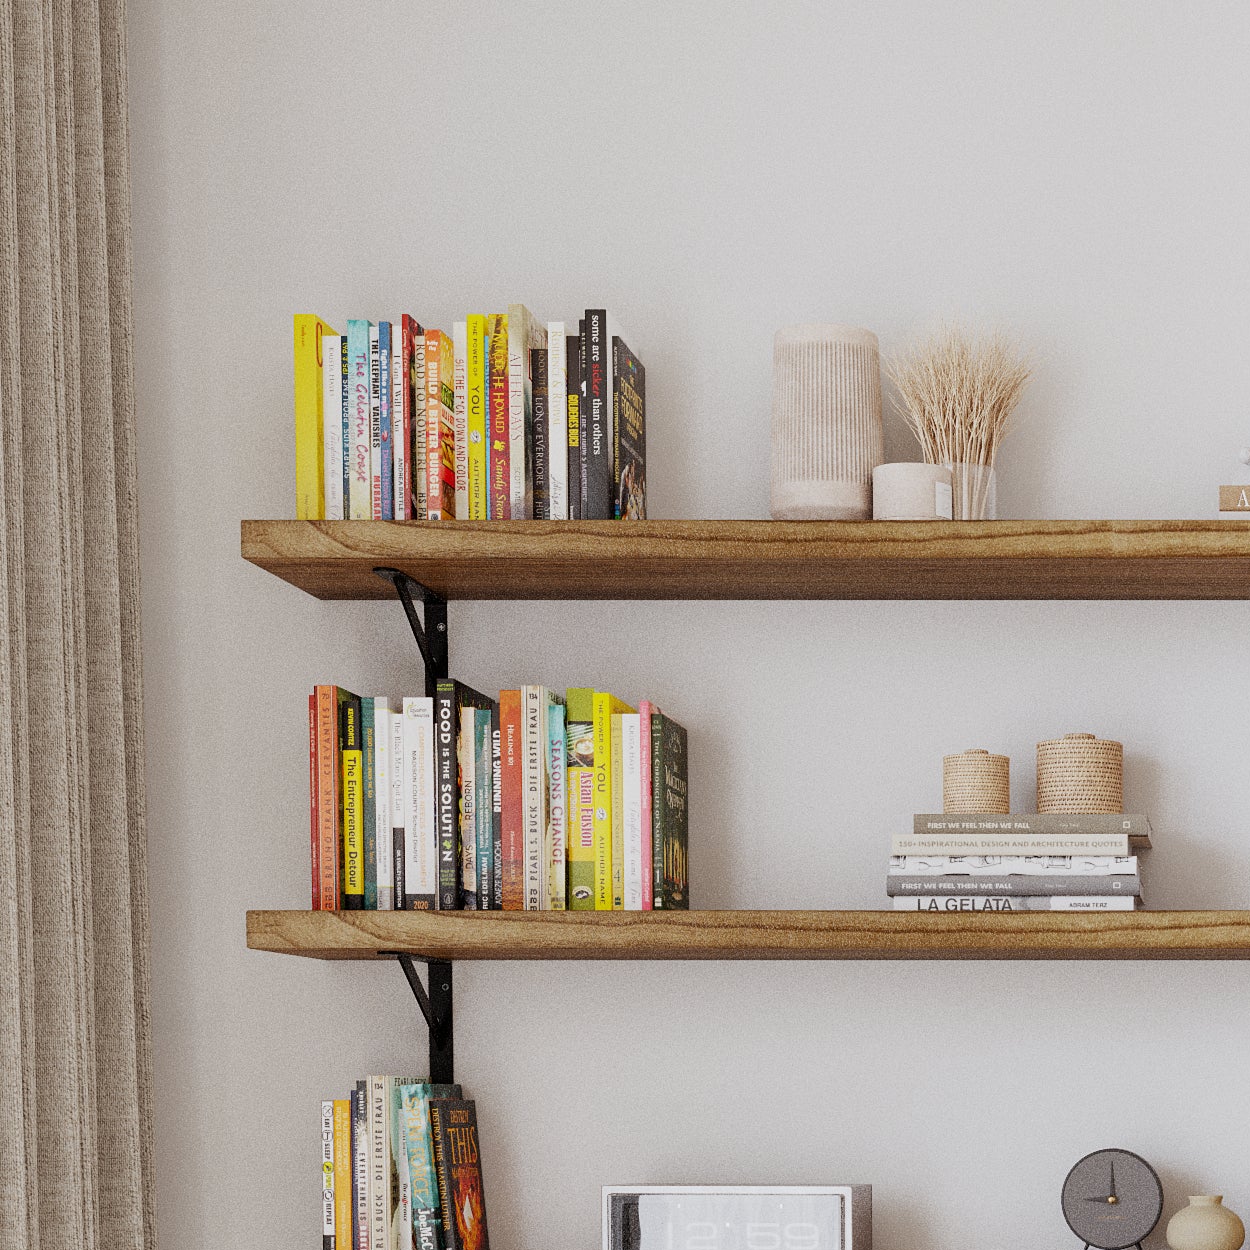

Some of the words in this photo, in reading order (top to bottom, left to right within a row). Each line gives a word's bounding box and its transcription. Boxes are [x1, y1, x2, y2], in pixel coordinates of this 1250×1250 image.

[592, 315, 600, 342] some
[372, 340, 380, 355] THE
[416, 344, 426, 380] ROAD
[592, 345, 600, 362] are
[357, 353, 368, 377] The
[372, 360, 380, 399] ELEPHANT
[428, 362, 439, 395] BUILD
[510, 353, 522, 399] AFTER
[592, 363, 602, 397] sicker
[416, 386, 426, 402] TO
[428, 398, 439, 406] A
[593, 398, 602, 421] than
[357, 383, 368, 438] Gelatin
[510, 405, 522, 442] DAYS
[568, 395, 579, 426] GOLDENES
[372, 406, 380, 448] VANISHES
[416, 409, 426, 473] NOWHERE
[428, 409, 439, 448] BETTER
[568, 429, 579, 447] BUCH
[593, 423, 602, 455] others
[357, 445, 368, 482] Coast
[428, 452, 439, 497] BURGER
[528, 707, 537, 735] FRAU
[348, 757, 357, 777] The
[528, 740, 537, 770] ERSTE
[551, 739, 561, 802] SEASONS
[528, 776, 537, 792] DIE
[581, 772, 594, 804] Asian
[346, 781, 357, 848] Entrepreneur
[528, 806, 537, 833] BUCK
[581, 807, 594, 848] Fusion
[927, 822, 946, 830] FIRST
[948, 822, 959, 830] WE
[961, 822, 978, 830] FEEL
[979, 822, 998, 830] THEN
[999, 822, 1012, 830] WE
[1014, 822, 1031, 830] FALL
[552, 806, 562, 865] CHANGE
[349, 851, 358, 888] Detour
[528, 849, 537, 881] PEARL
[902, 882, 922, 890] FIRST
[924, 882, 937, 890] WE
[939, 882, 956, 890] FEEL
[958, 882, 978, 890] THEN
[980, 882, 993, 890] WE
[995, 882, 1013, 890] FALL
[413, 900, 429, 910] 2020
[918, 898, 939, 911] LA
[945, 898, 1013, 911] GELATA
[375, 1097, 383, 1124] FRAU
[431, 1107, 441, 1142] DESTROY
[375, 1129, 383, 1159] ERSTE
[436, 1144, 444, 1161] THIS
[447, 1127, 478, 1164] THIS
[375, 1164, 383, 1181] DIE
[437, 1166, 447, 1200] MARTIN
[375, 1194, 383, 1222] BUCK
[440, 1201, 451, 1232] LUTHER
